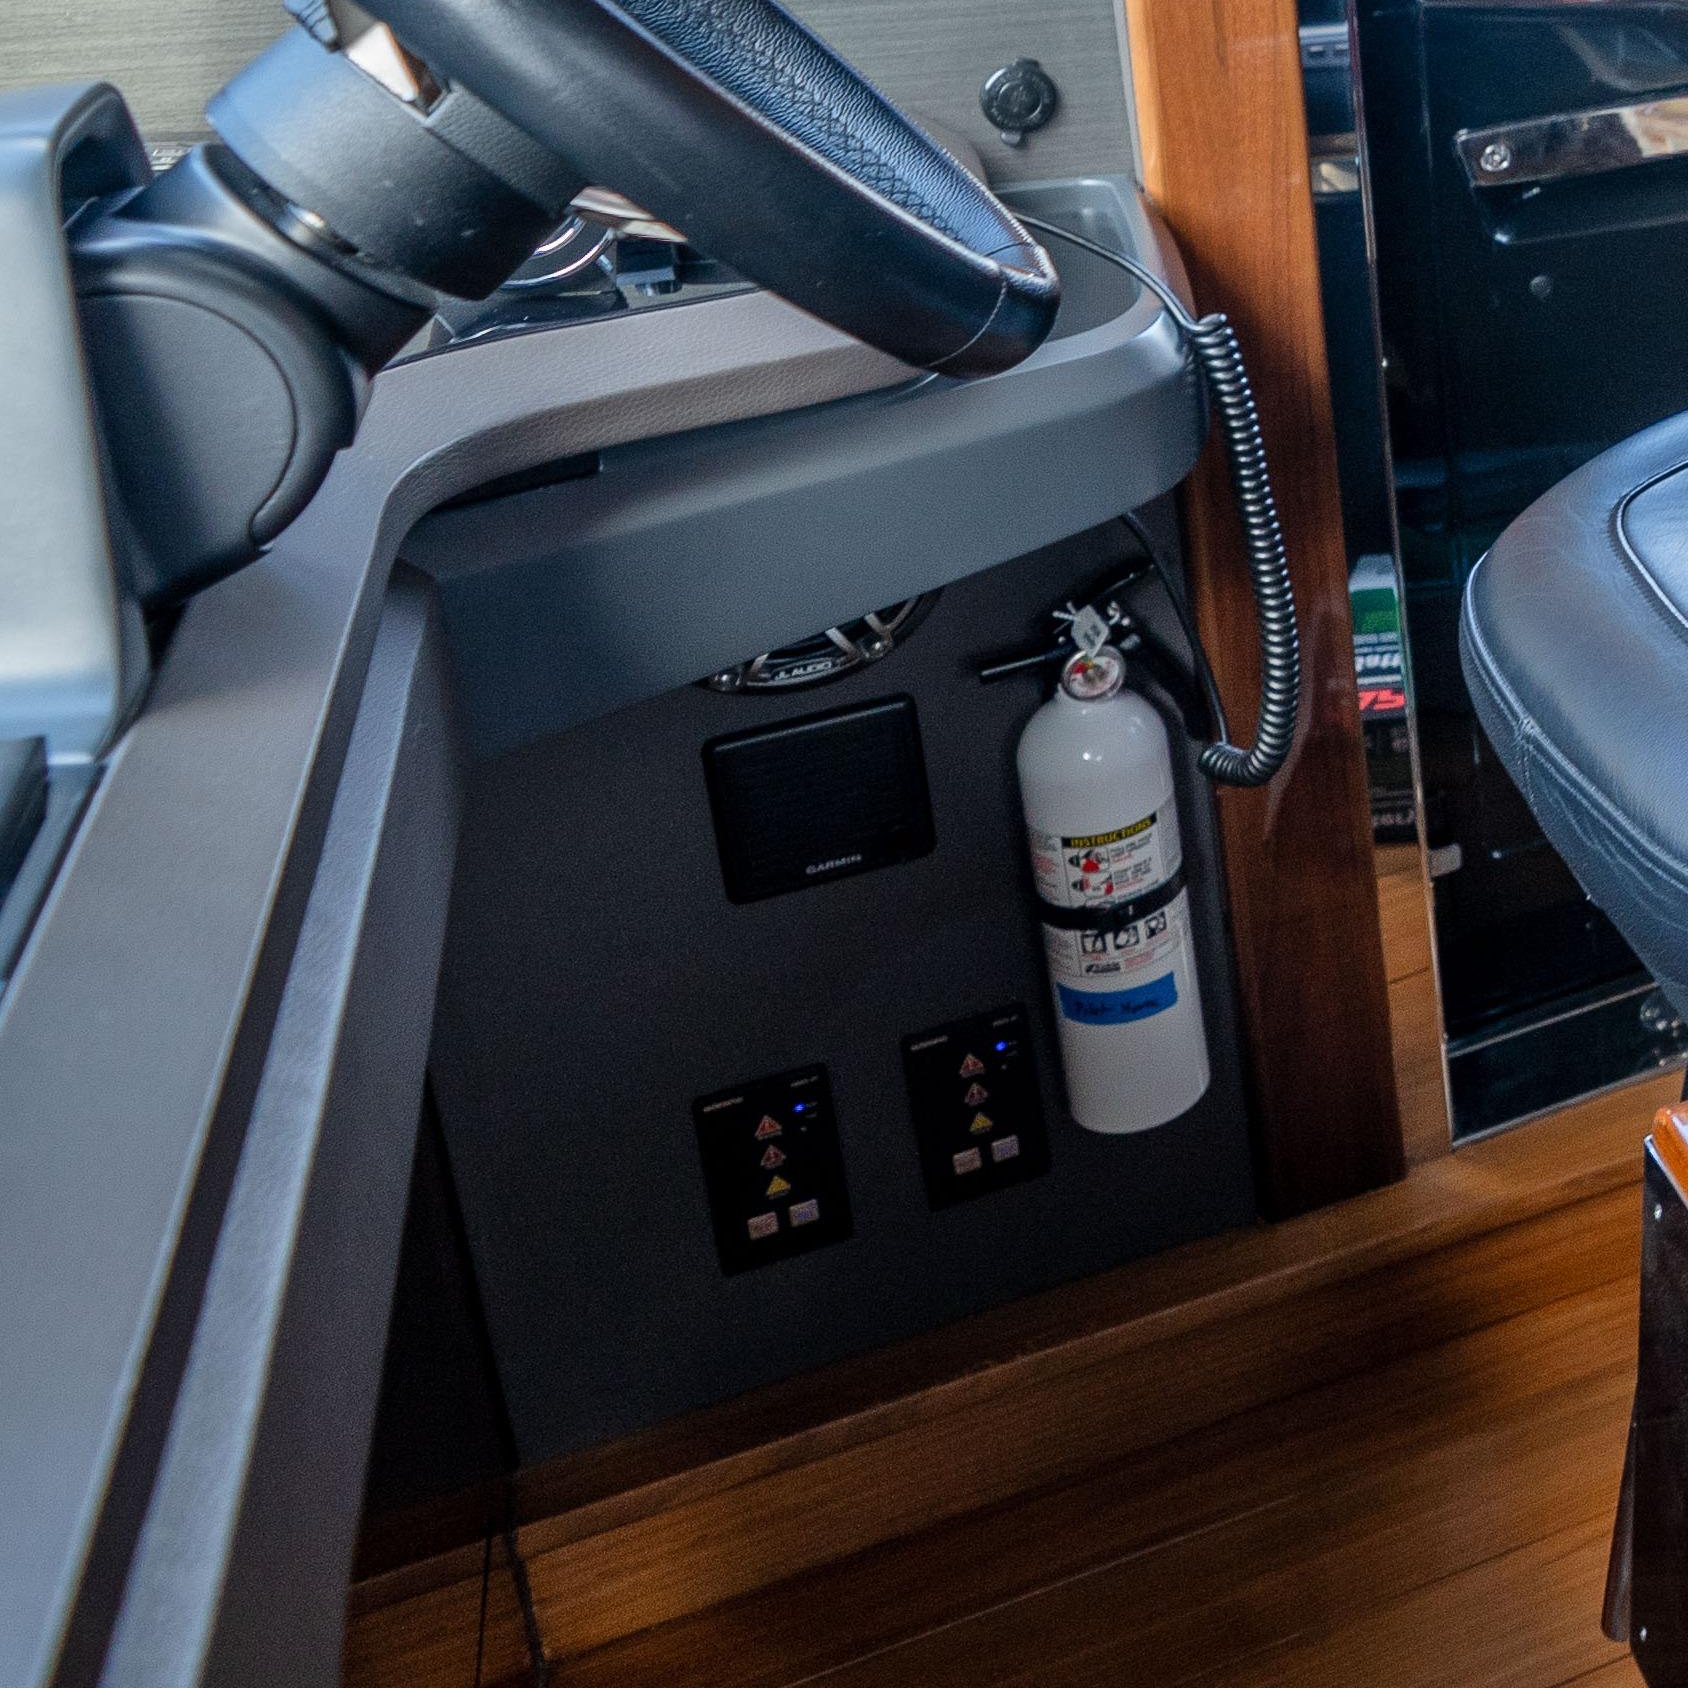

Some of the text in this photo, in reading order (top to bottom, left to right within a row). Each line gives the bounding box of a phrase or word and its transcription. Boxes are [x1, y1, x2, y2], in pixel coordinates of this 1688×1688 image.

[790, 660, 832, 677] AUDIO
[1070, 817, 1153, 847] INSTRUCTIONS
[804, 853, 864, 875] GARMIN
